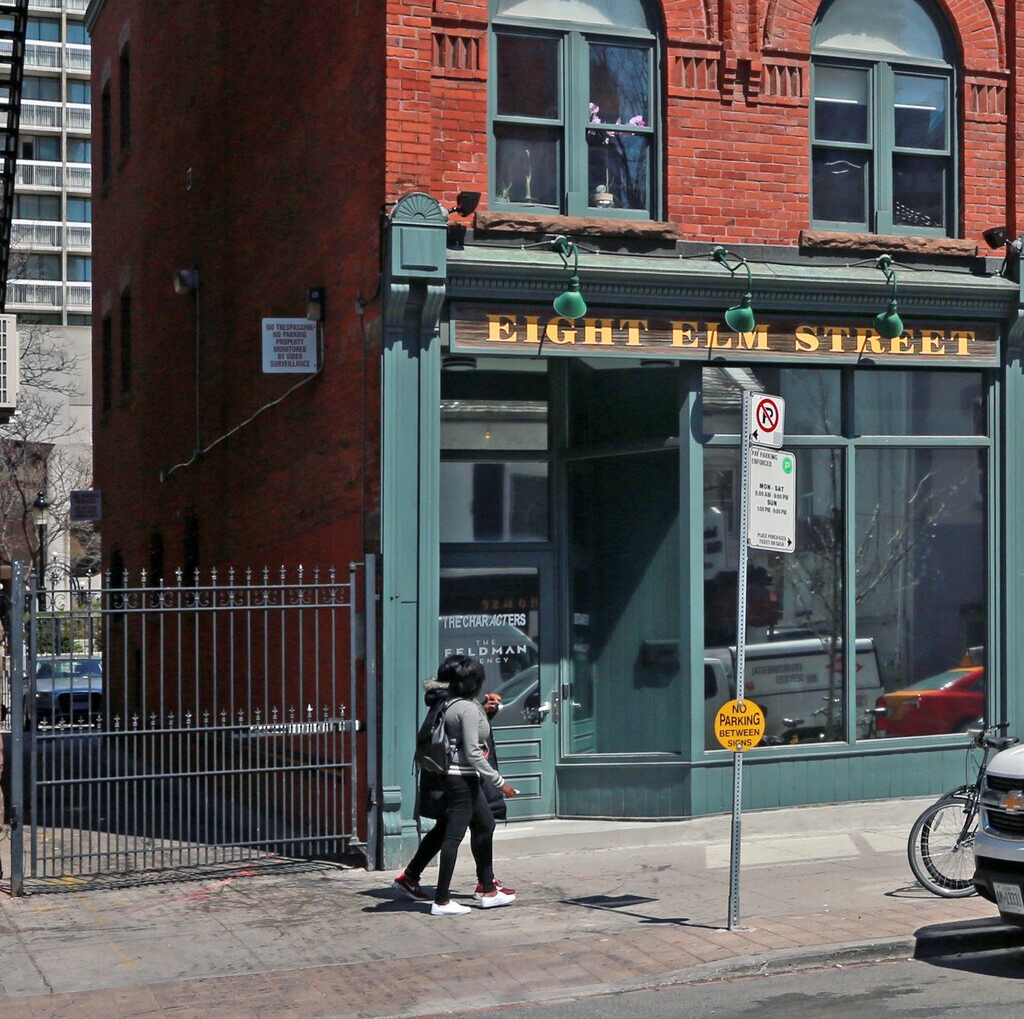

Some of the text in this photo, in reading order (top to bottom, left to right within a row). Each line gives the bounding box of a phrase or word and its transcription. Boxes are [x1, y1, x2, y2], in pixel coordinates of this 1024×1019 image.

[485, 313, 977, 357] EIGHT ELM STREET
[760, 451, 778, 461] PARKING
[751, 458, 772, 467] ENFORCED
[462, 613, 527, 628] CHARACTERS
[444, 645, 527, 658] FELDMAN
[732, 704, 747, 713] NO
[720, 713, 760, 726] PARKING
[719, 729, 760, 737] BETWEEN
[727, 739, 752, 747] SIGNS
